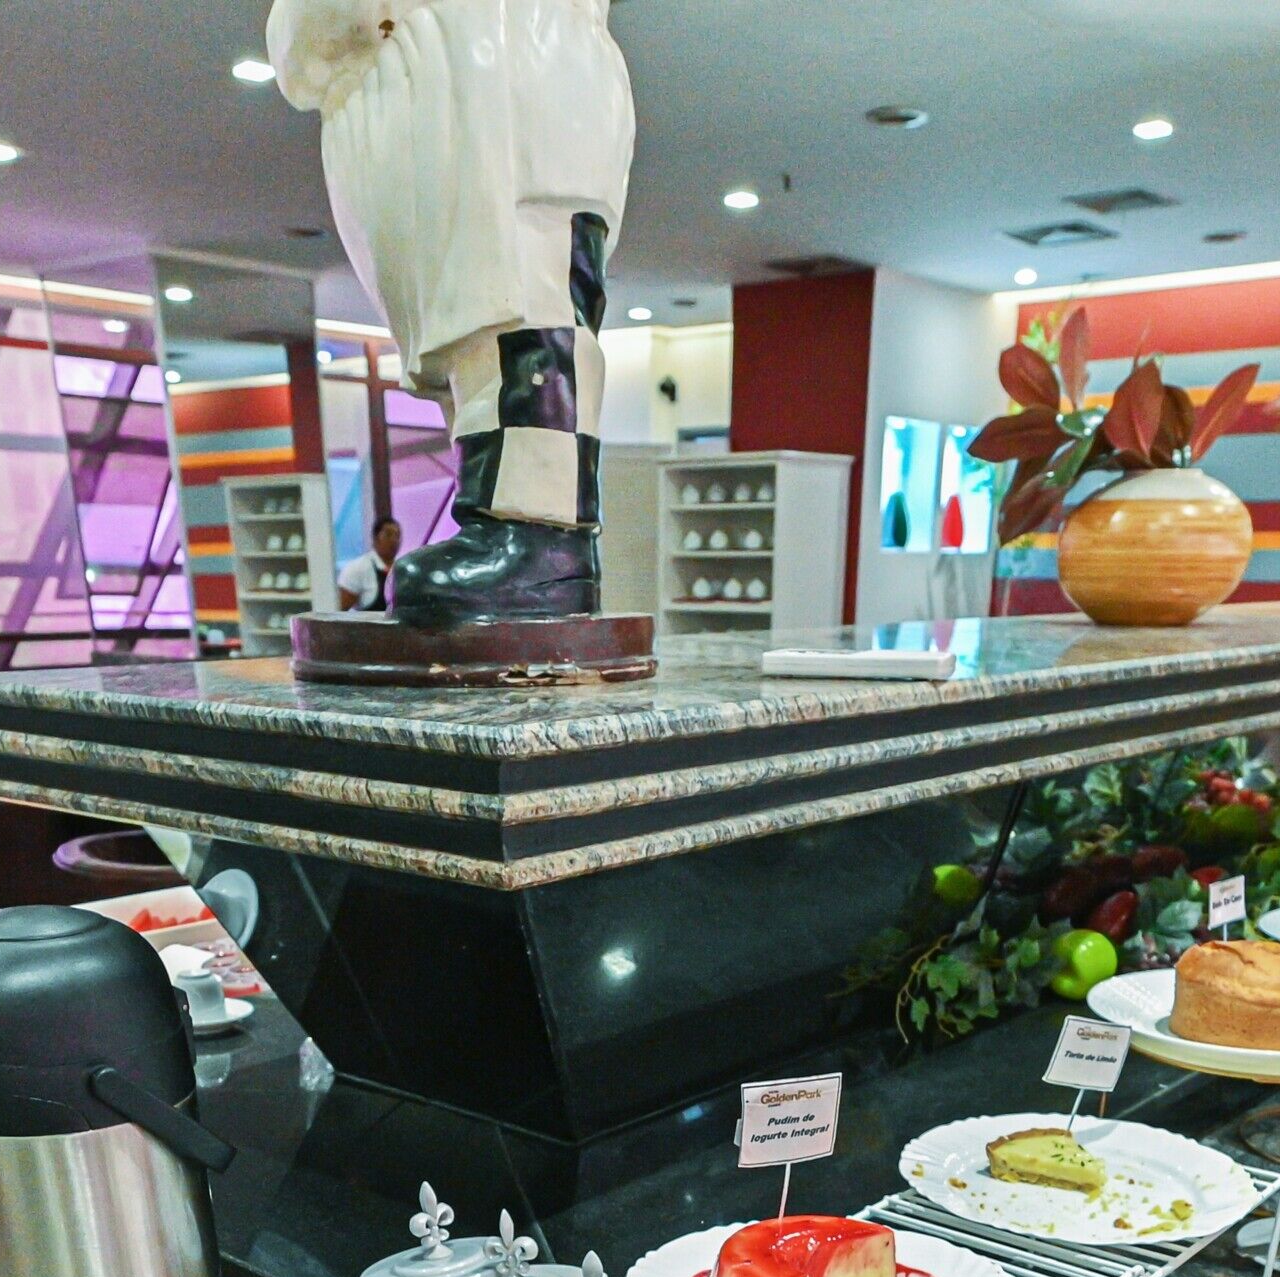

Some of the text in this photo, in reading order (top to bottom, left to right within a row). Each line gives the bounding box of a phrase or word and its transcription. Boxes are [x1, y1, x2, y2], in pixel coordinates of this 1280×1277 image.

[760, 1088, 822, 1105] GoldenPark
[767, 1113, 815, 1127] Pudim de
[751, 1124, 830, 1144] Iogurte Integral
